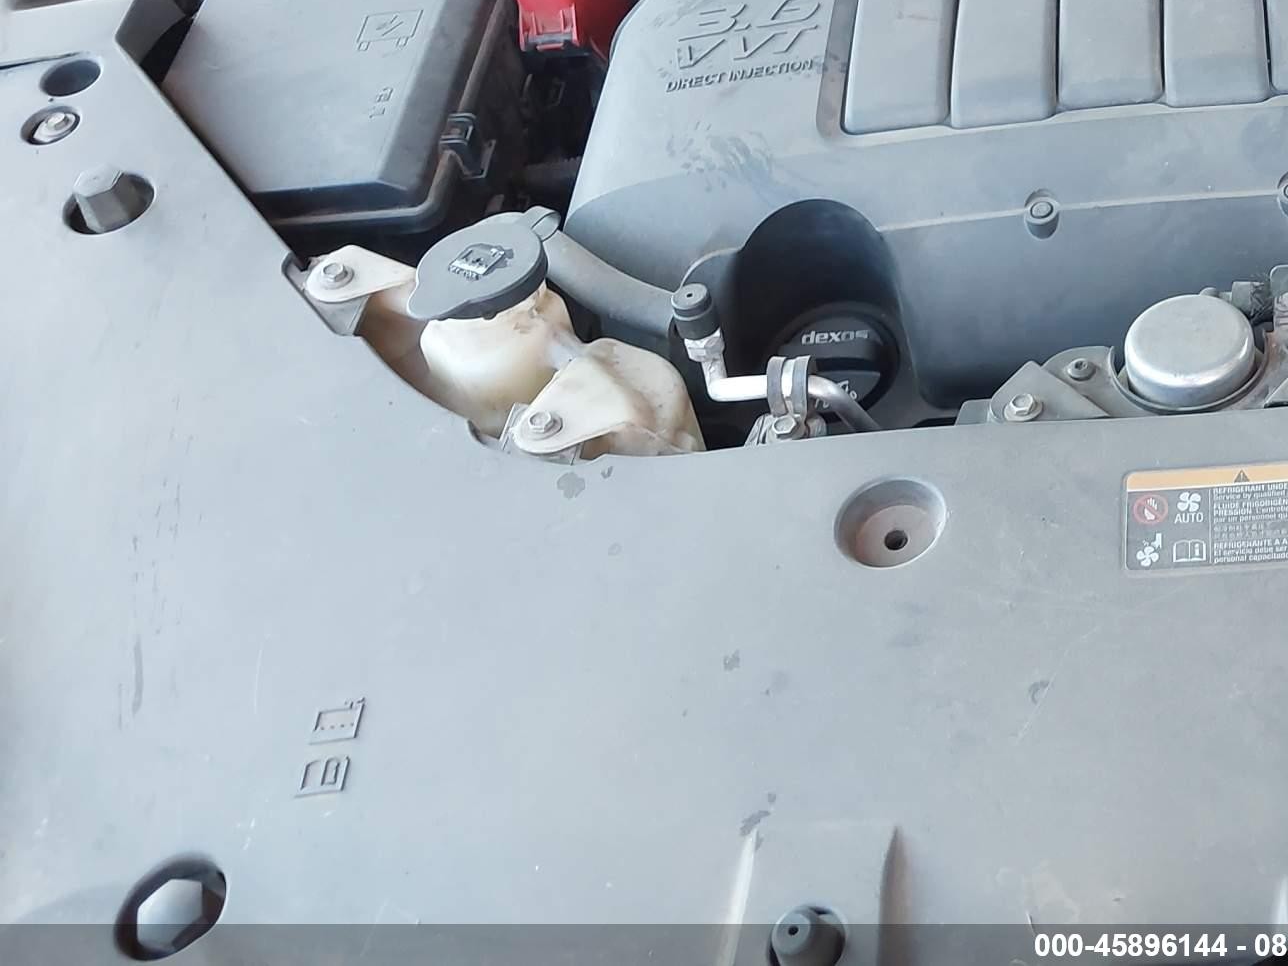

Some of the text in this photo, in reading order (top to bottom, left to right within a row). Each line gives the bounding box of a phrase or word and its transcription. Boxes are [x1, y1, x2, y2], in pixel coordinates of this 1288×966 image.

[677, 23, 818, 69] VVT
[666, 59, 815, 93] DIRECT INJECTION
[802, 329, 870, 345] dexos
[1174, 511, 1203, 524] AUTO
